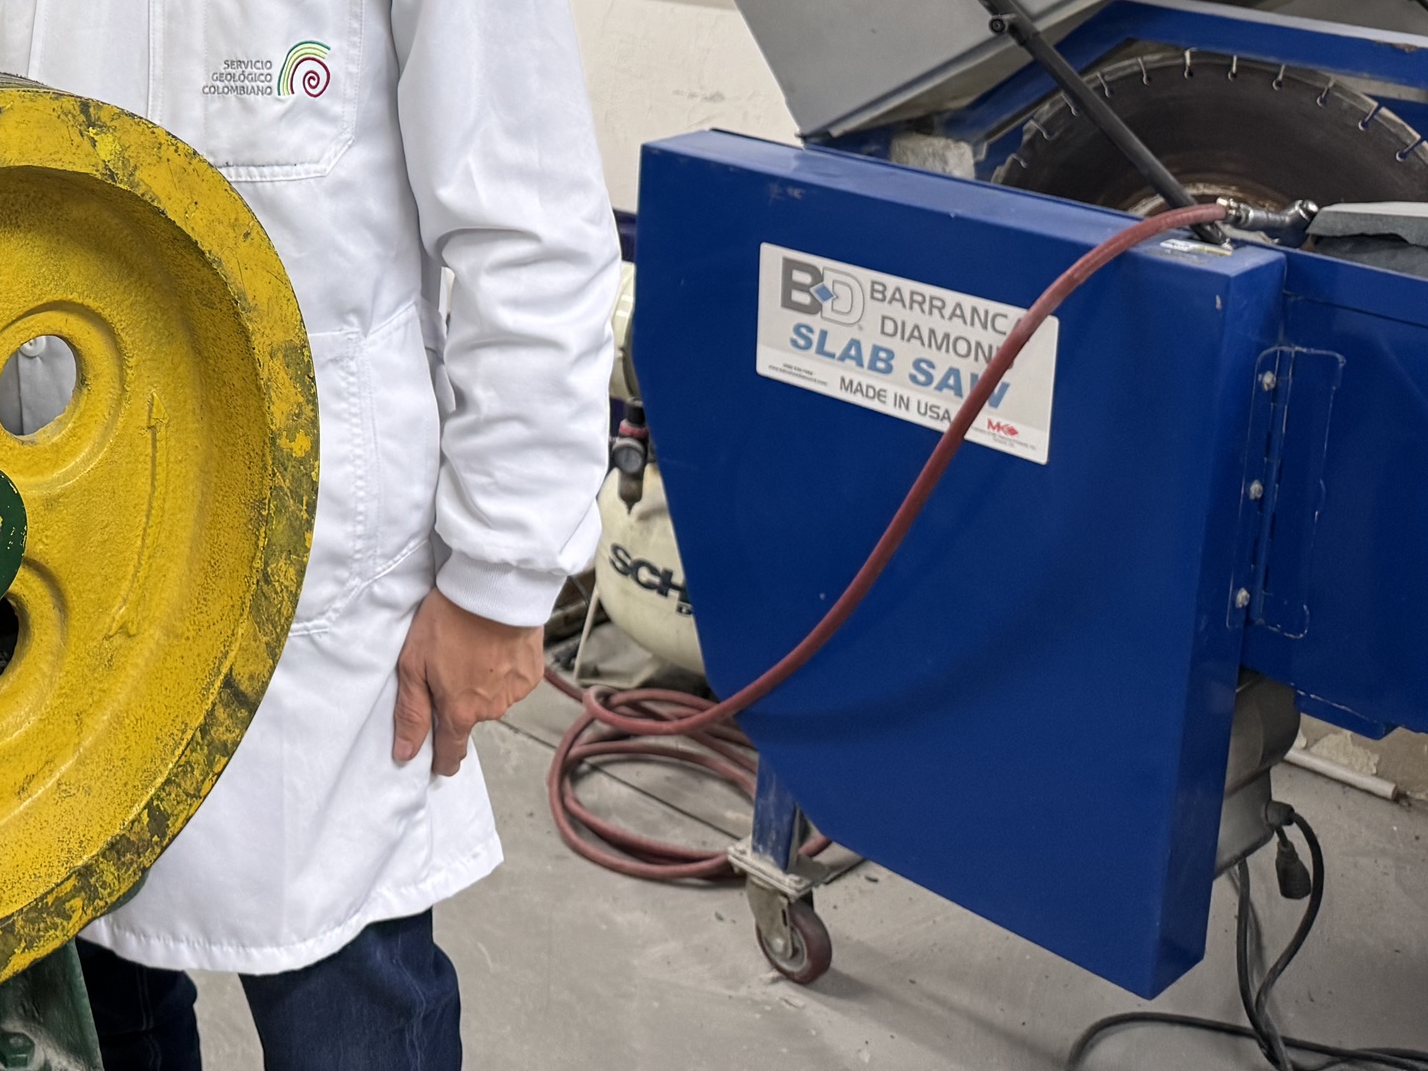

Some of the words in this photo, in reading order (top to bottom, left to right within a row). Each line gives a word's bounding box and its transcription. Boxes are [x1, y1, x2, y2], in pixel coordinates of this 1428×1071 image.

[211, 70, 272, 83] GEOLÓGICO
[223, 59, 272, 70] SERVICIO
[201, 85, 272, 96] COLOMBIANO
[869, 279, 1022, 336] BARRANC
[789, 321, 896, 375] SLAB
[879, 314, 1014, 370] DIAMON
[839, 375, 888, 405] MADE
[893, 391, 911, 412] IN
[916, 399, 952, 424] USA
